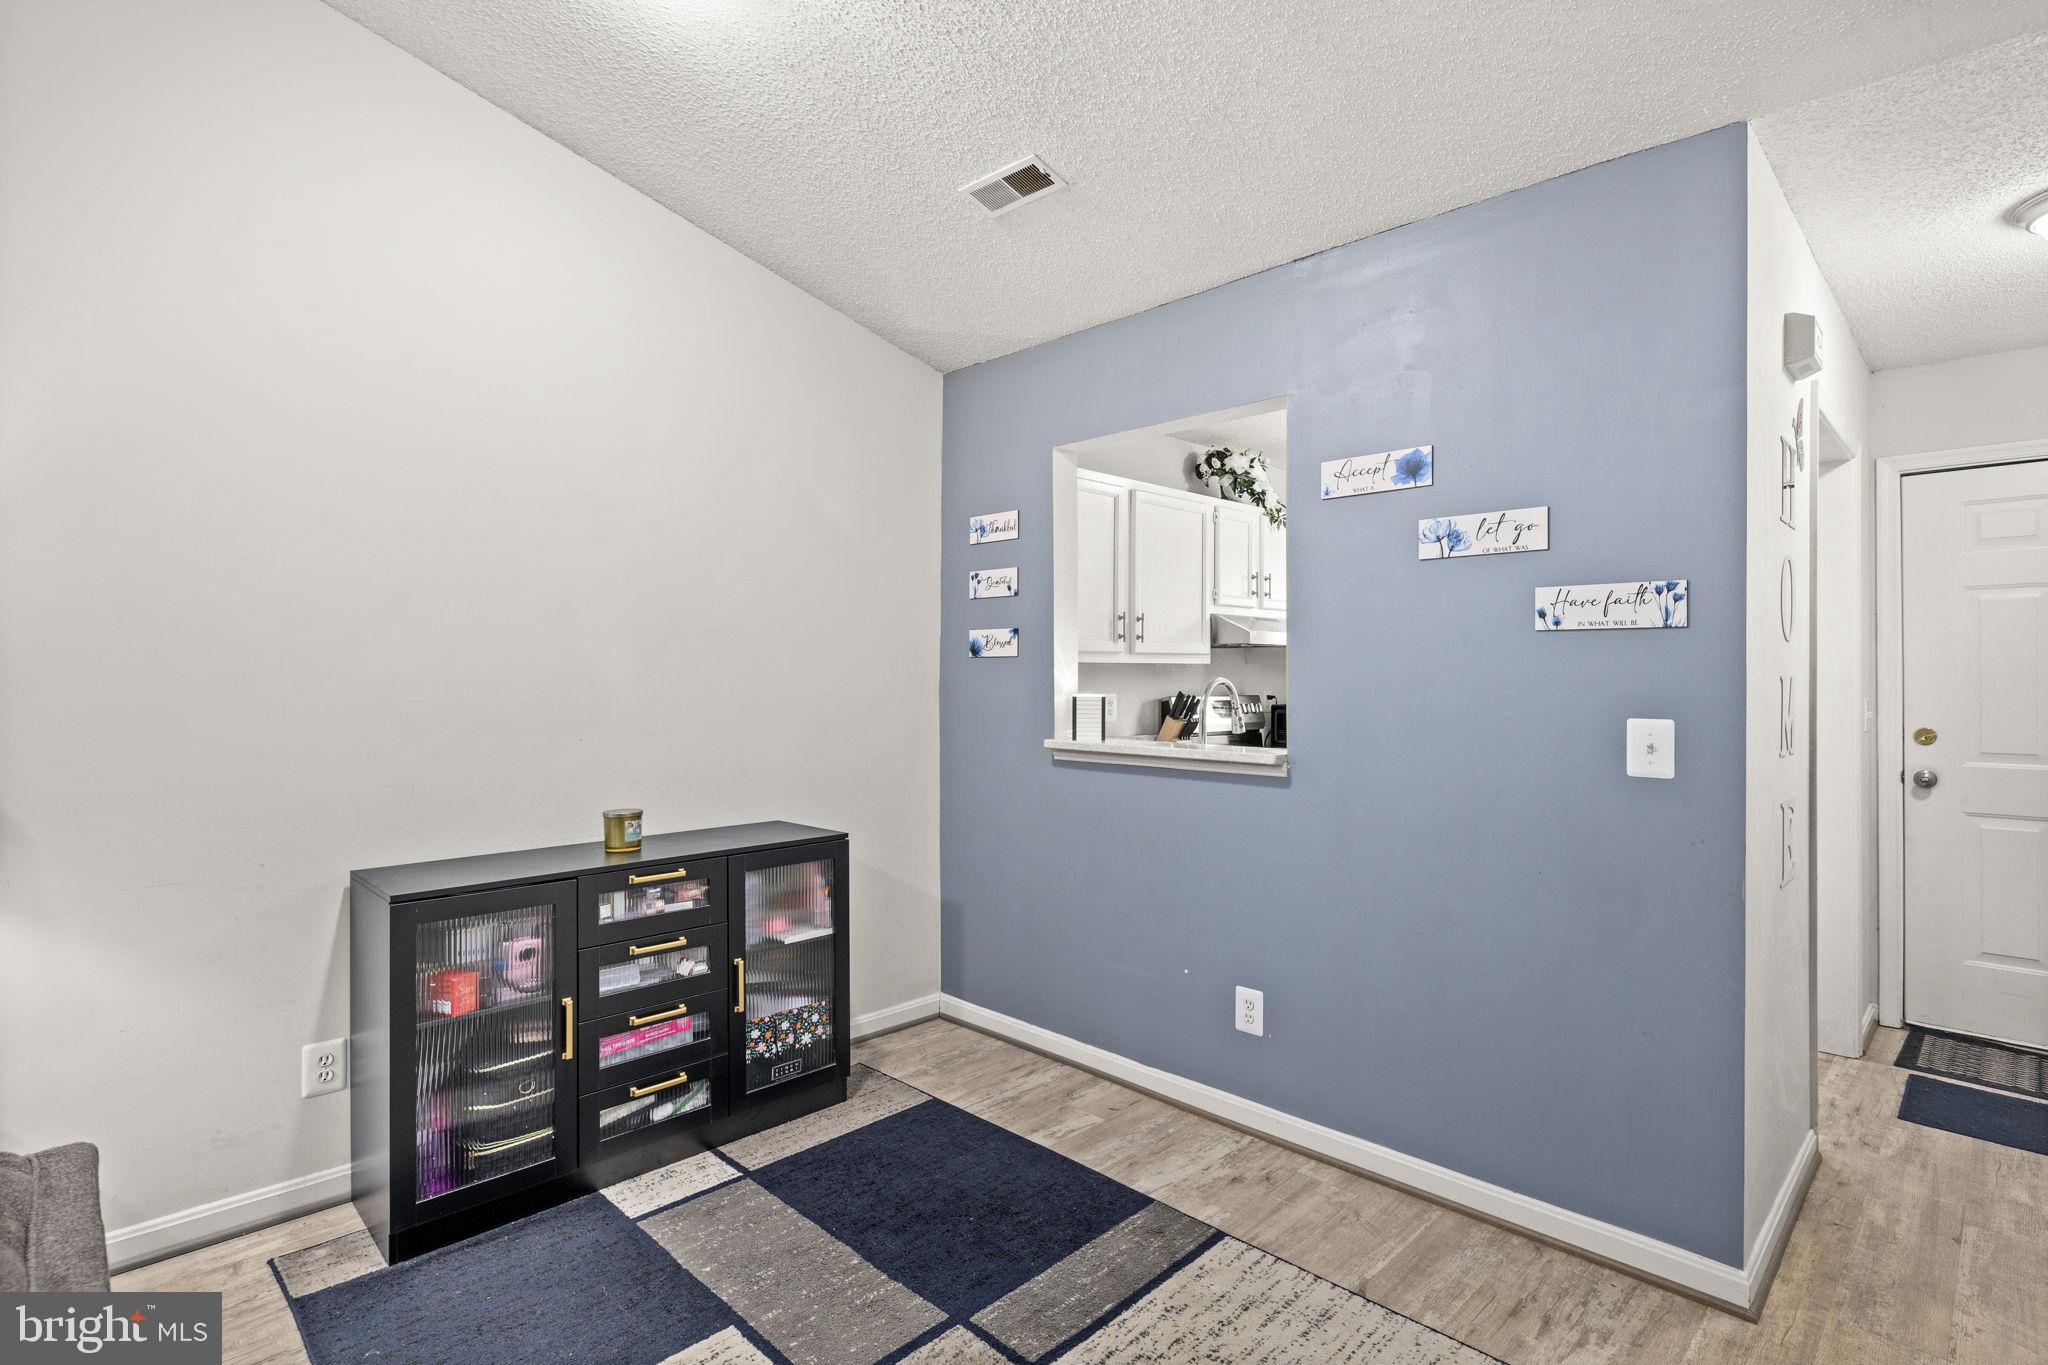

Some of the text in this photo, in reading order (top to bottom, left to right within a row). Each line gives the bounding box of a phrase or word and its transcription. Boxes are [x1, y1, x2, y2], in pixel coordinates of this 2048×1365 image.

[1333, 453, 1399, 490] Accept
[1475, 512, 1540, 545] let go
[1493, 545, 1513, 553] WHAT
[1515, 544, 1530, 552] WAS
[1550, 583, 1654, 618] Have faith
[1577, 620, 1586, 628] IN
[1588, 619, 1610, 627] WHAT
[1612, 619, 1628, 627] WILL
[982, 633, 1014, 652] Blessed
